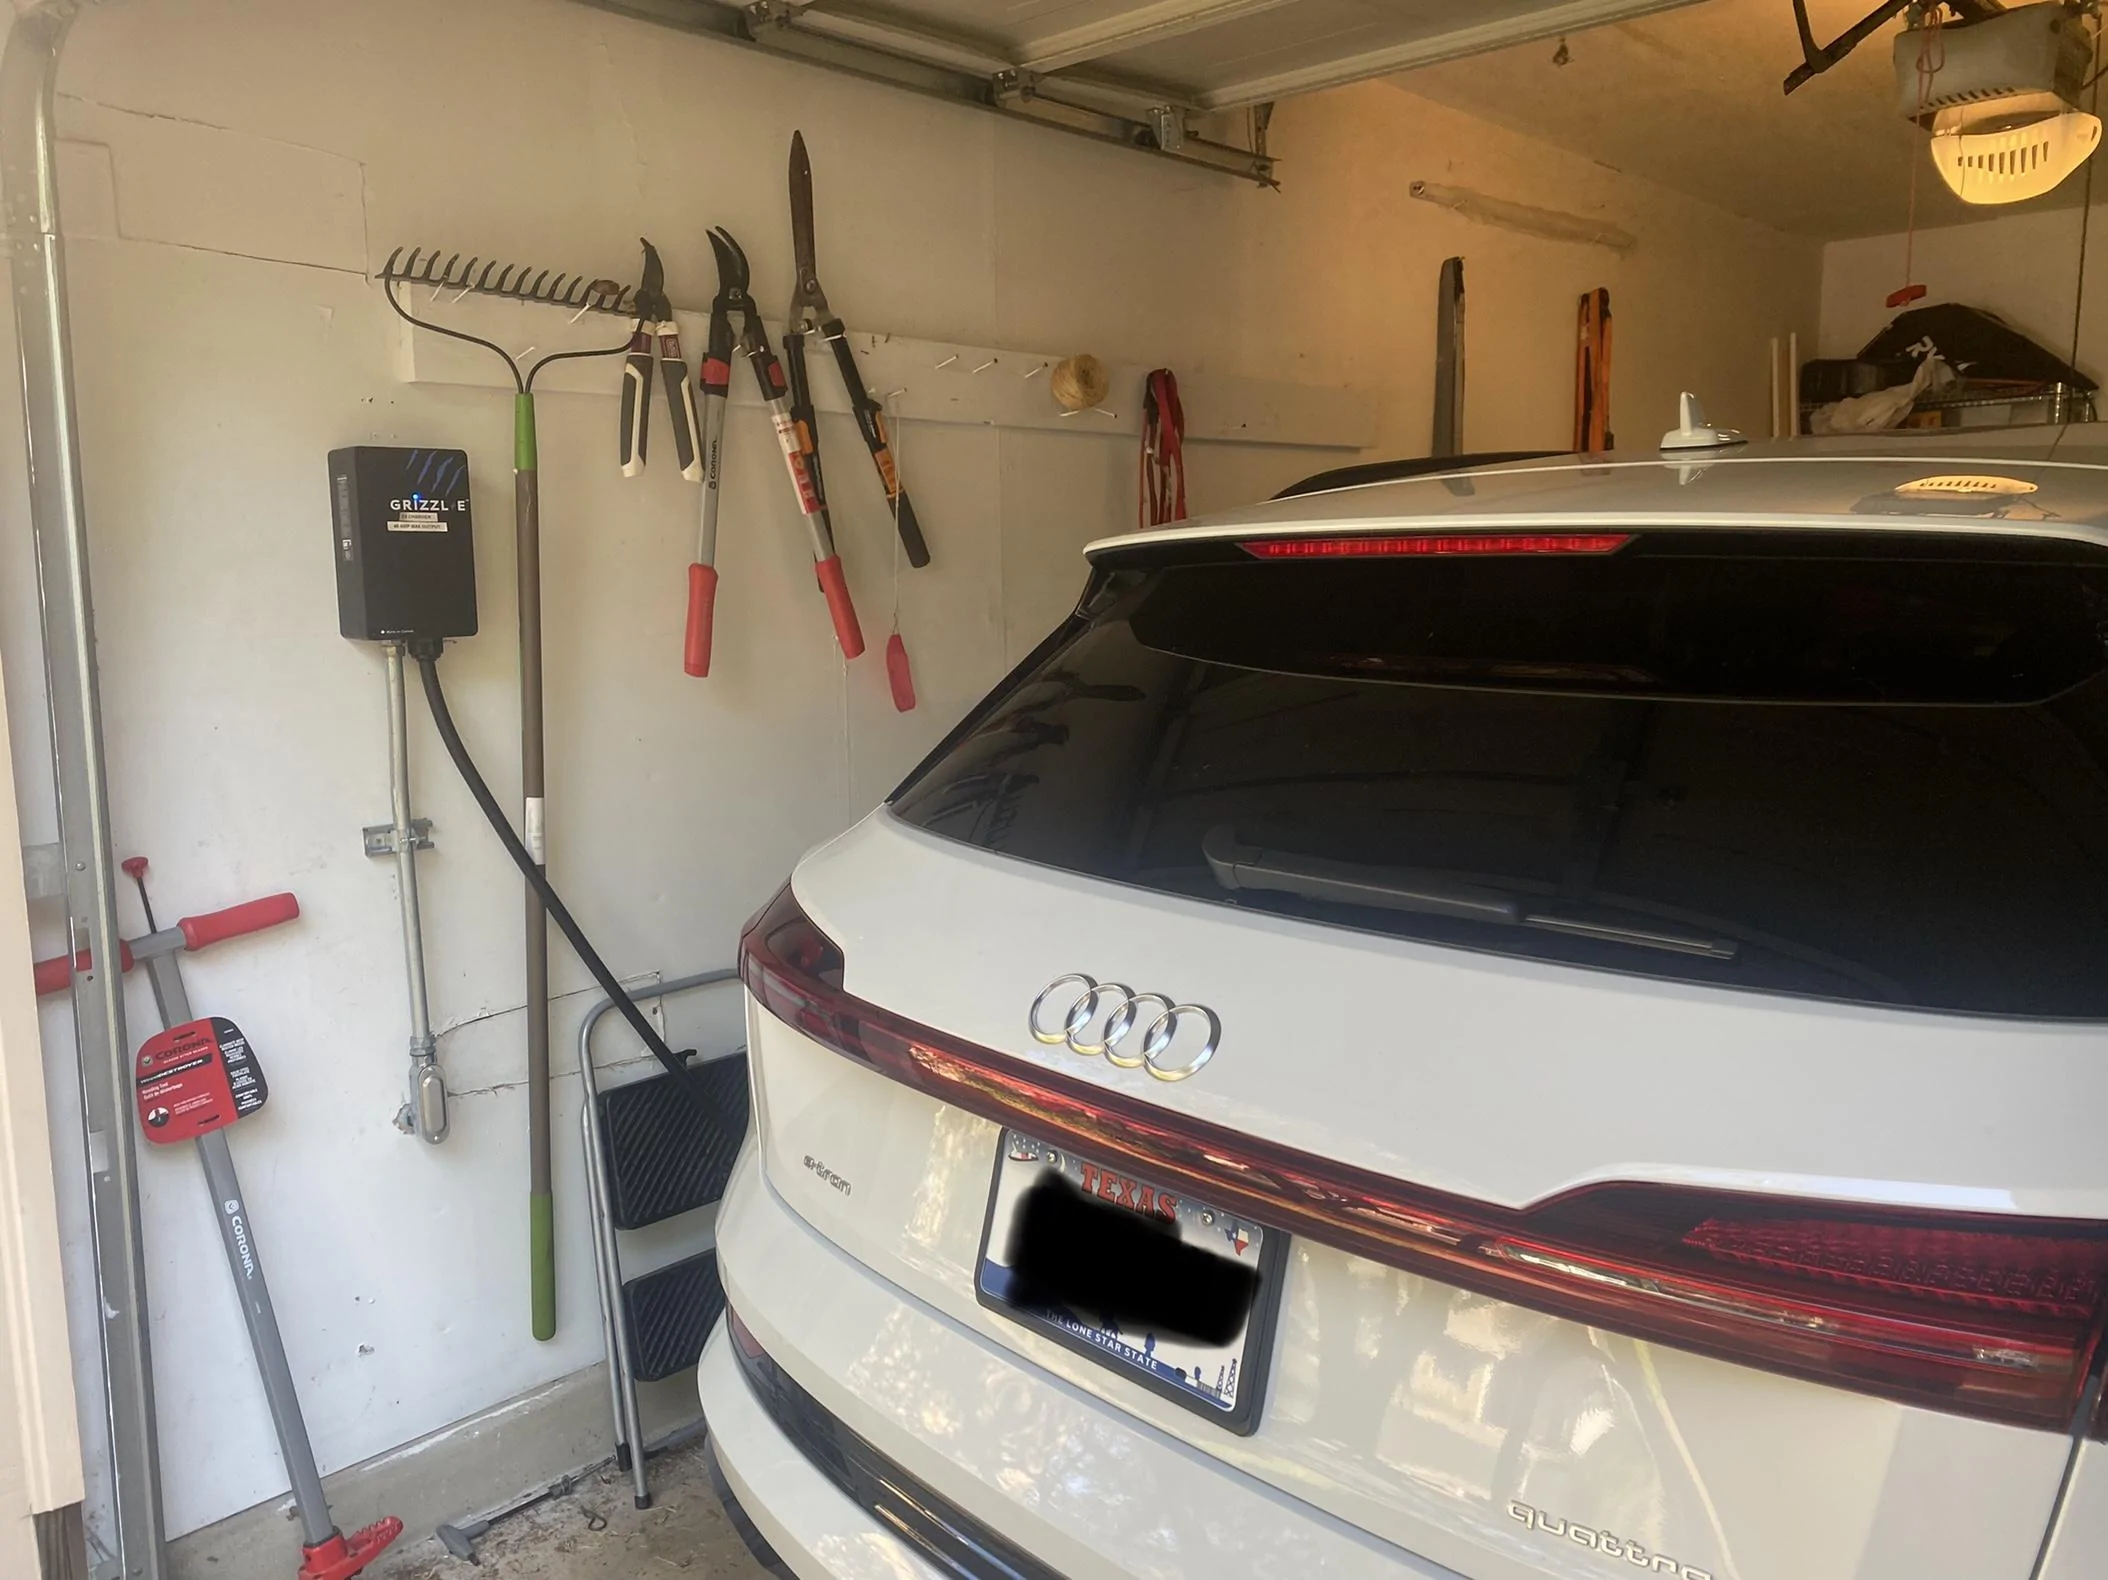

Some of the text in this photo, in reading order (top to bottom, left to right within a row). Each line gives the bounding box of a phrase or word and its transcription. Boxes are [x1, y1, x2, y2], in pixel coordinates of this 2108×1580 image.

[1081, 1161, 1177, 1224] TEXAS
[232, 1215, 254, 1277] CORONA
[1046, 1308, 1158, 1370] THE LONE STAR STATE
